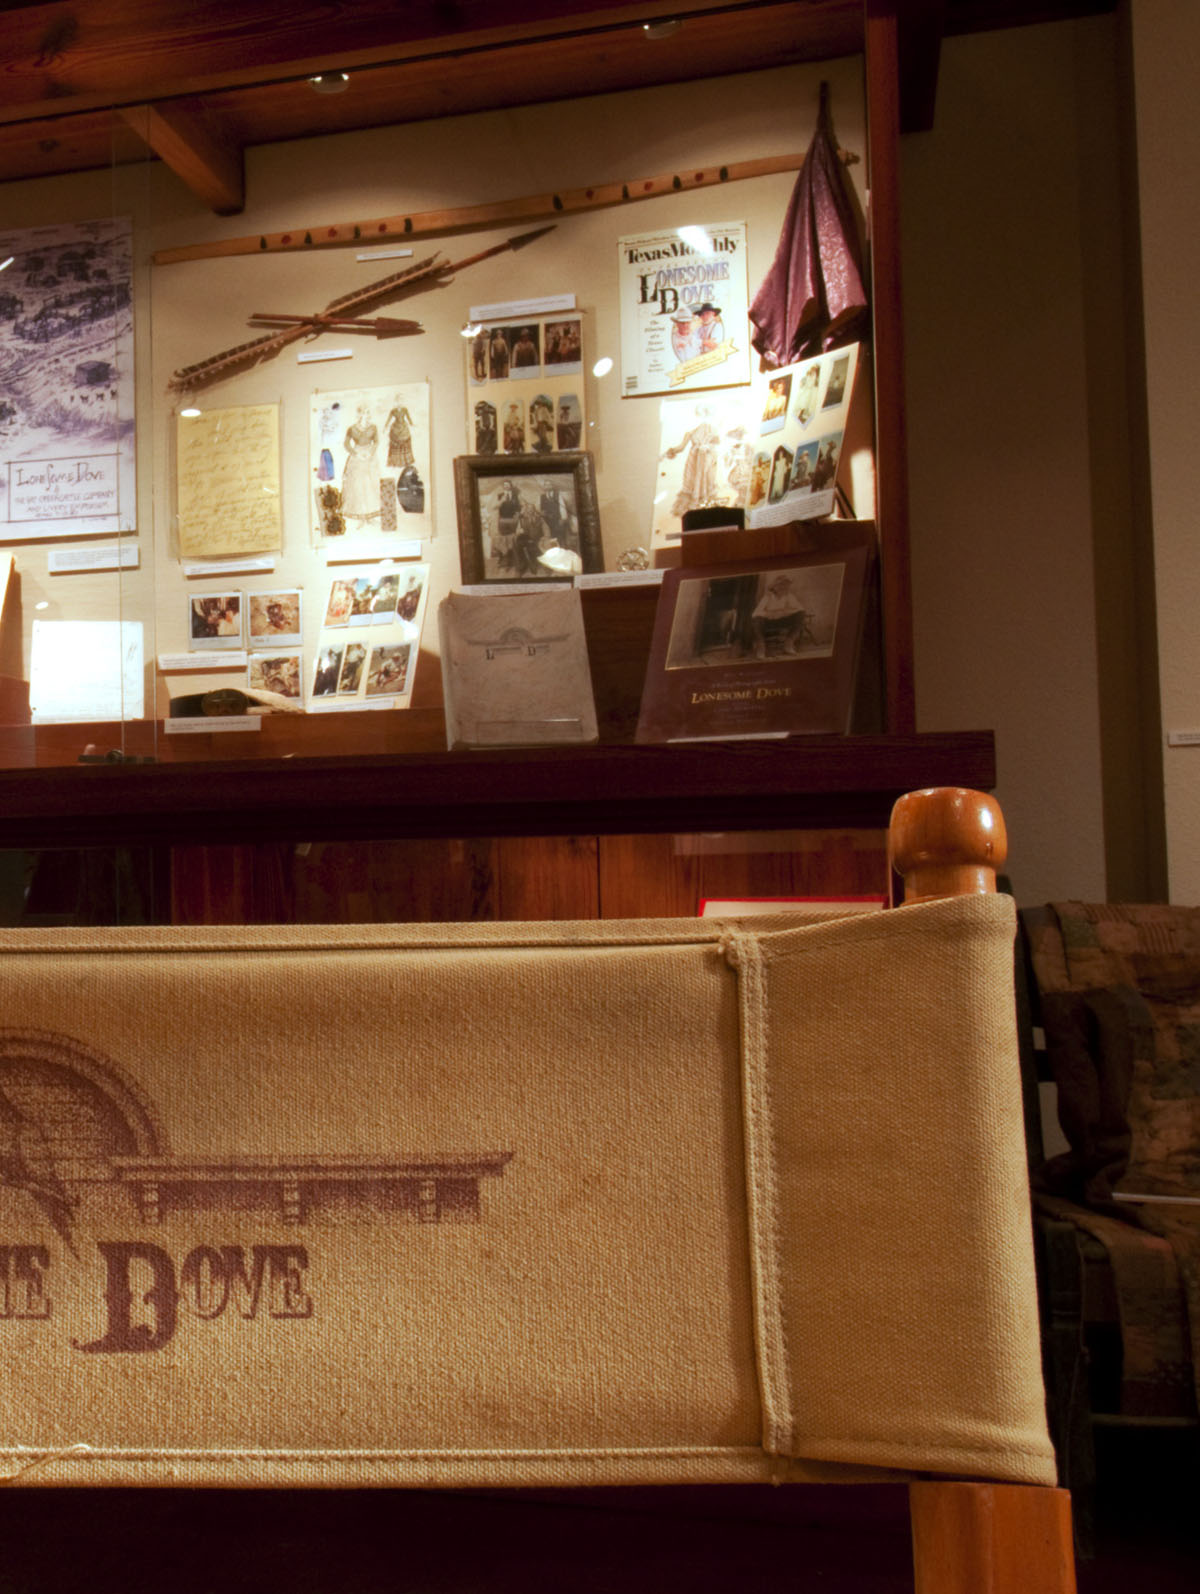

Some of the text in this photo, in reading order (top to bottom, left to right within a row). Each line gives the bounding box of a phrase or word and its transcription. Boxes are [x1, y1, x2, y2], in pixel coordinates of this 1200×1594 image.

[637, 261, 730, 304] LONESOME
[652, 283, 715, 315] DOVE
[691, 687, 792, 704] LONESOME DOVE
[72, 1240, 313, 1354] DOVE
